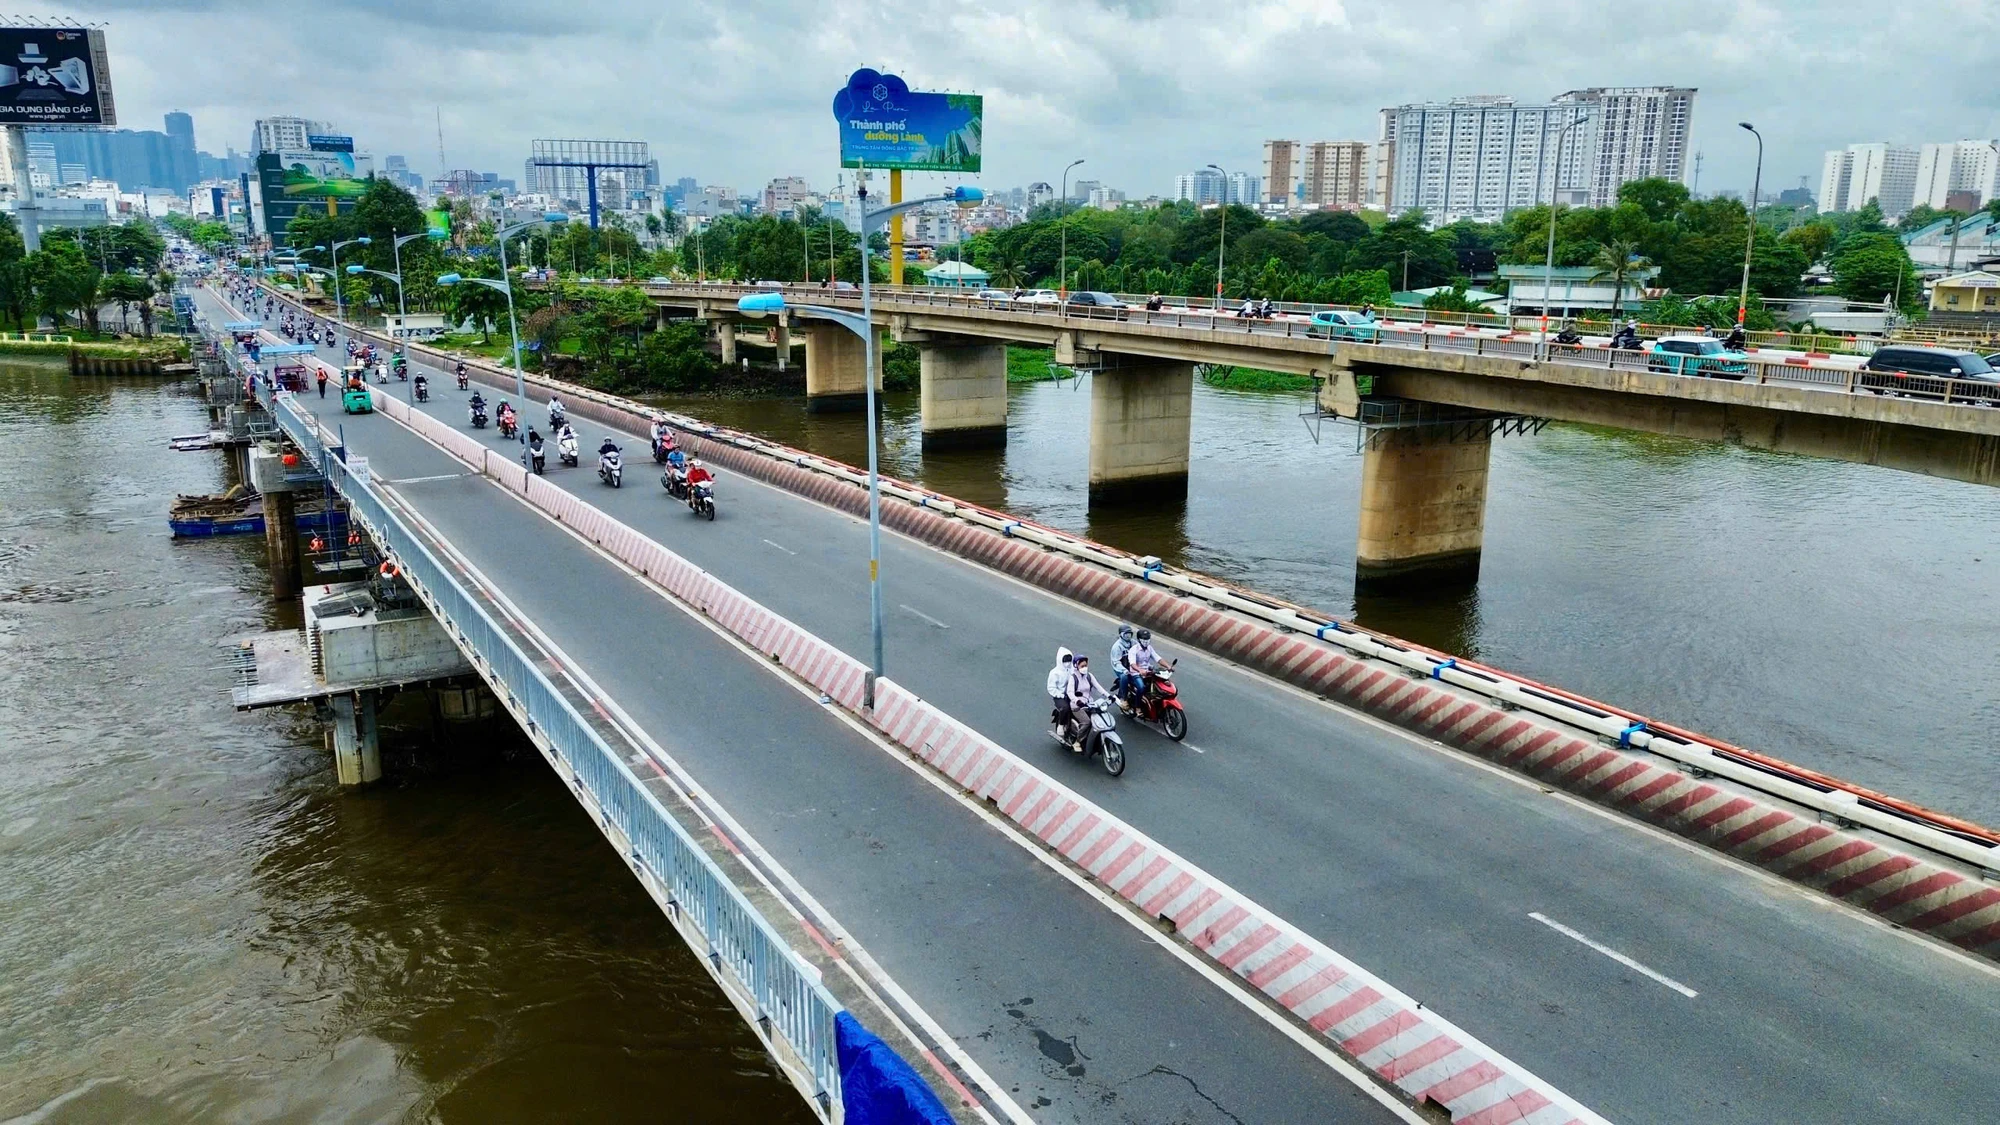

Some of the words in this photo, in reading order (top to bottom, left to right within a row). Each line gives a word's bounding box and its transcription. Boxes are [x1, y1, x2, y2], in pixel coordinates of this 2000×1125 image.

[16, 106, 43, 115] DỤNG
[44, 103, 71, 114] ĐẲNG
[72, 103, 92, 114] CẤP
[849, 119, 883, 130] Thành
[885, 118, 907, 131] phố
[864, 130, 899, 144] dưỡng
